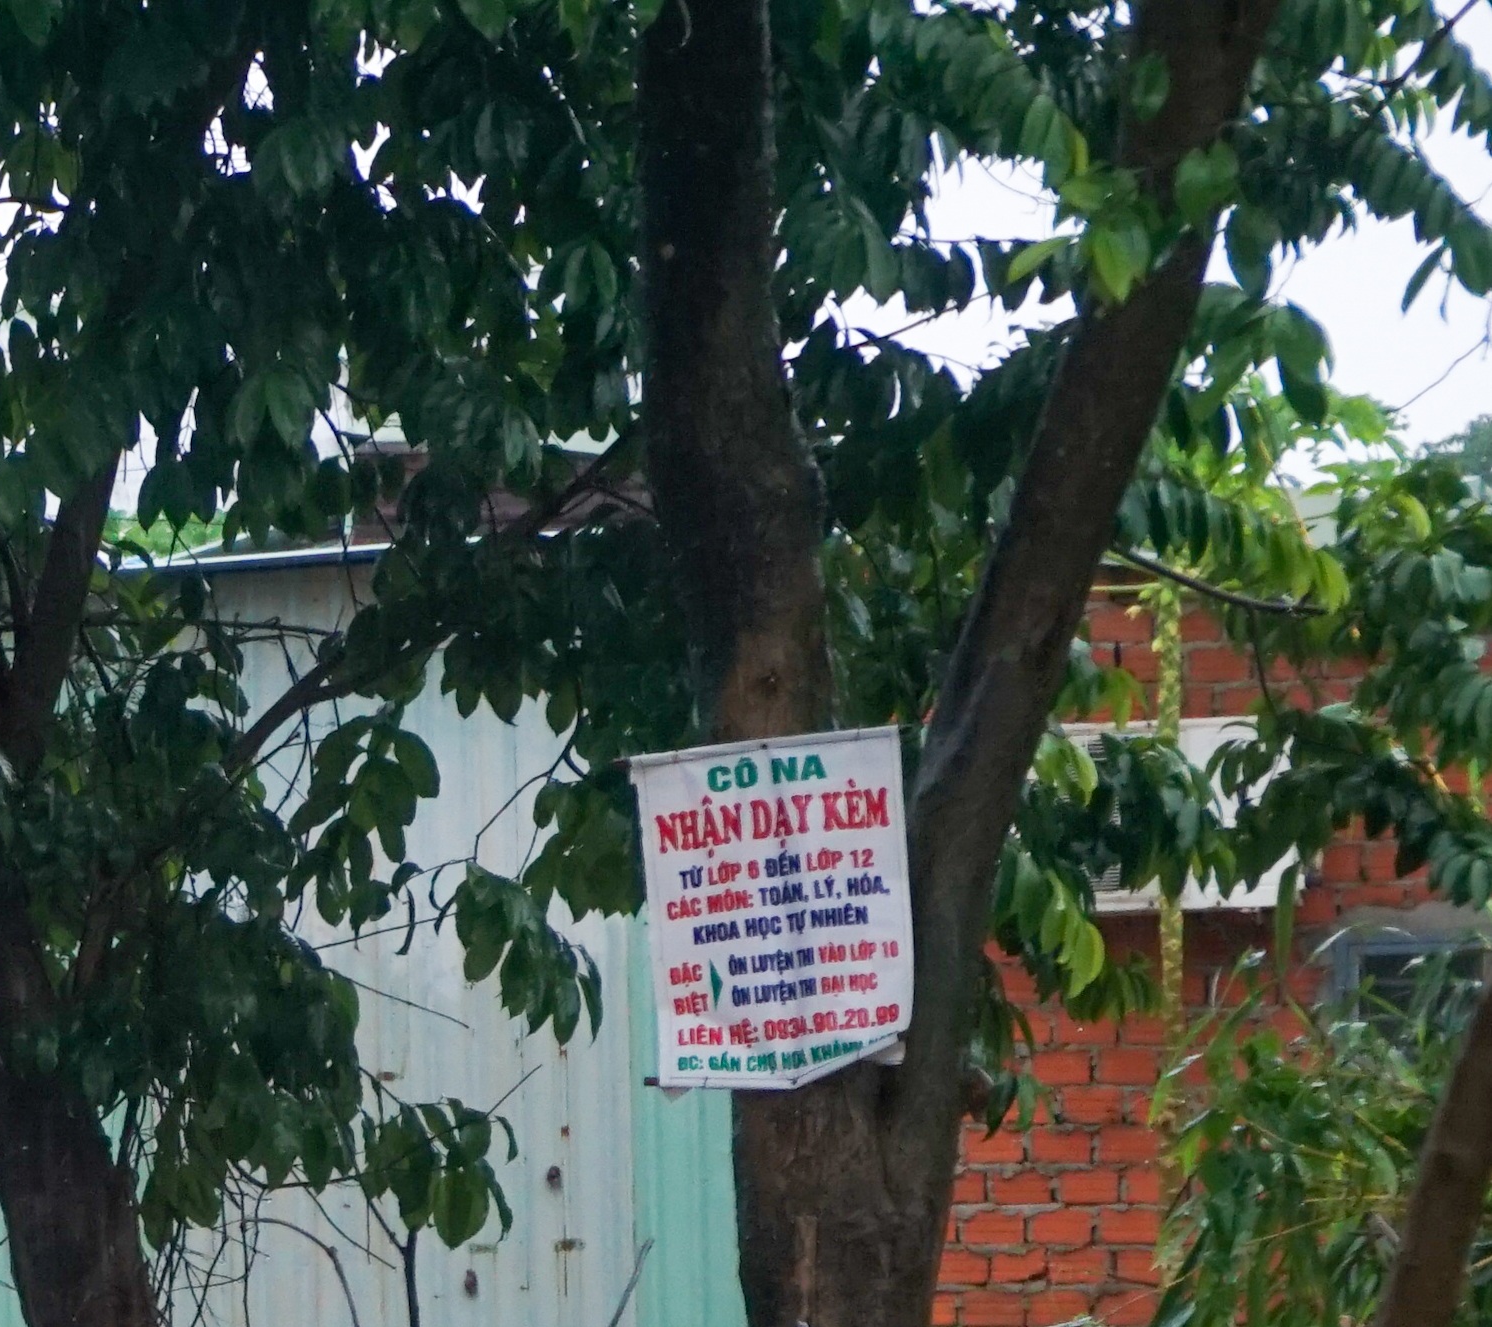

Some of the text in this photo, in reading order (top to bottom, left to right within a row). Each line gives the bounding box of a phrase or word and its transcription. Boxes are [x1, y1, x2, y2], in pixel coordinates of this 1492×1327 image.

[707, 754, 827, 792] CÔ NA
[654, 778, 890, 858] NHẬN DẠY KÈM
[679, 846, 874, 890] TỪ LỚP 6 ĐẾN LỚP 12
[667, 895, 702, 920] CÁC
[707, 889, 754, 914] MÔN:
[758, 880, 809, 907] TOÁN,
[814, 874, 842, 899] LÝ,
[693, 902, 869, 945] KHOA HỌC TỰ NHIÊN
[669, 962, 703, 988] ĐẶC
[728, 954, 748, 976] ÔN
[752, 949, 795, 975] LUYỆN
[796, 947, 814, 968] THI
[818, 944, 847, 964] VÀO
[673, 992, 709, 1017] BIỆT
[731, 985, 751, 1007] ÔN
[754, 979, 797, 1005] LUYỆN
[678, 1024, 723, 1046] LIÊN
[730, 1018, 759, 1048] HỆ:
